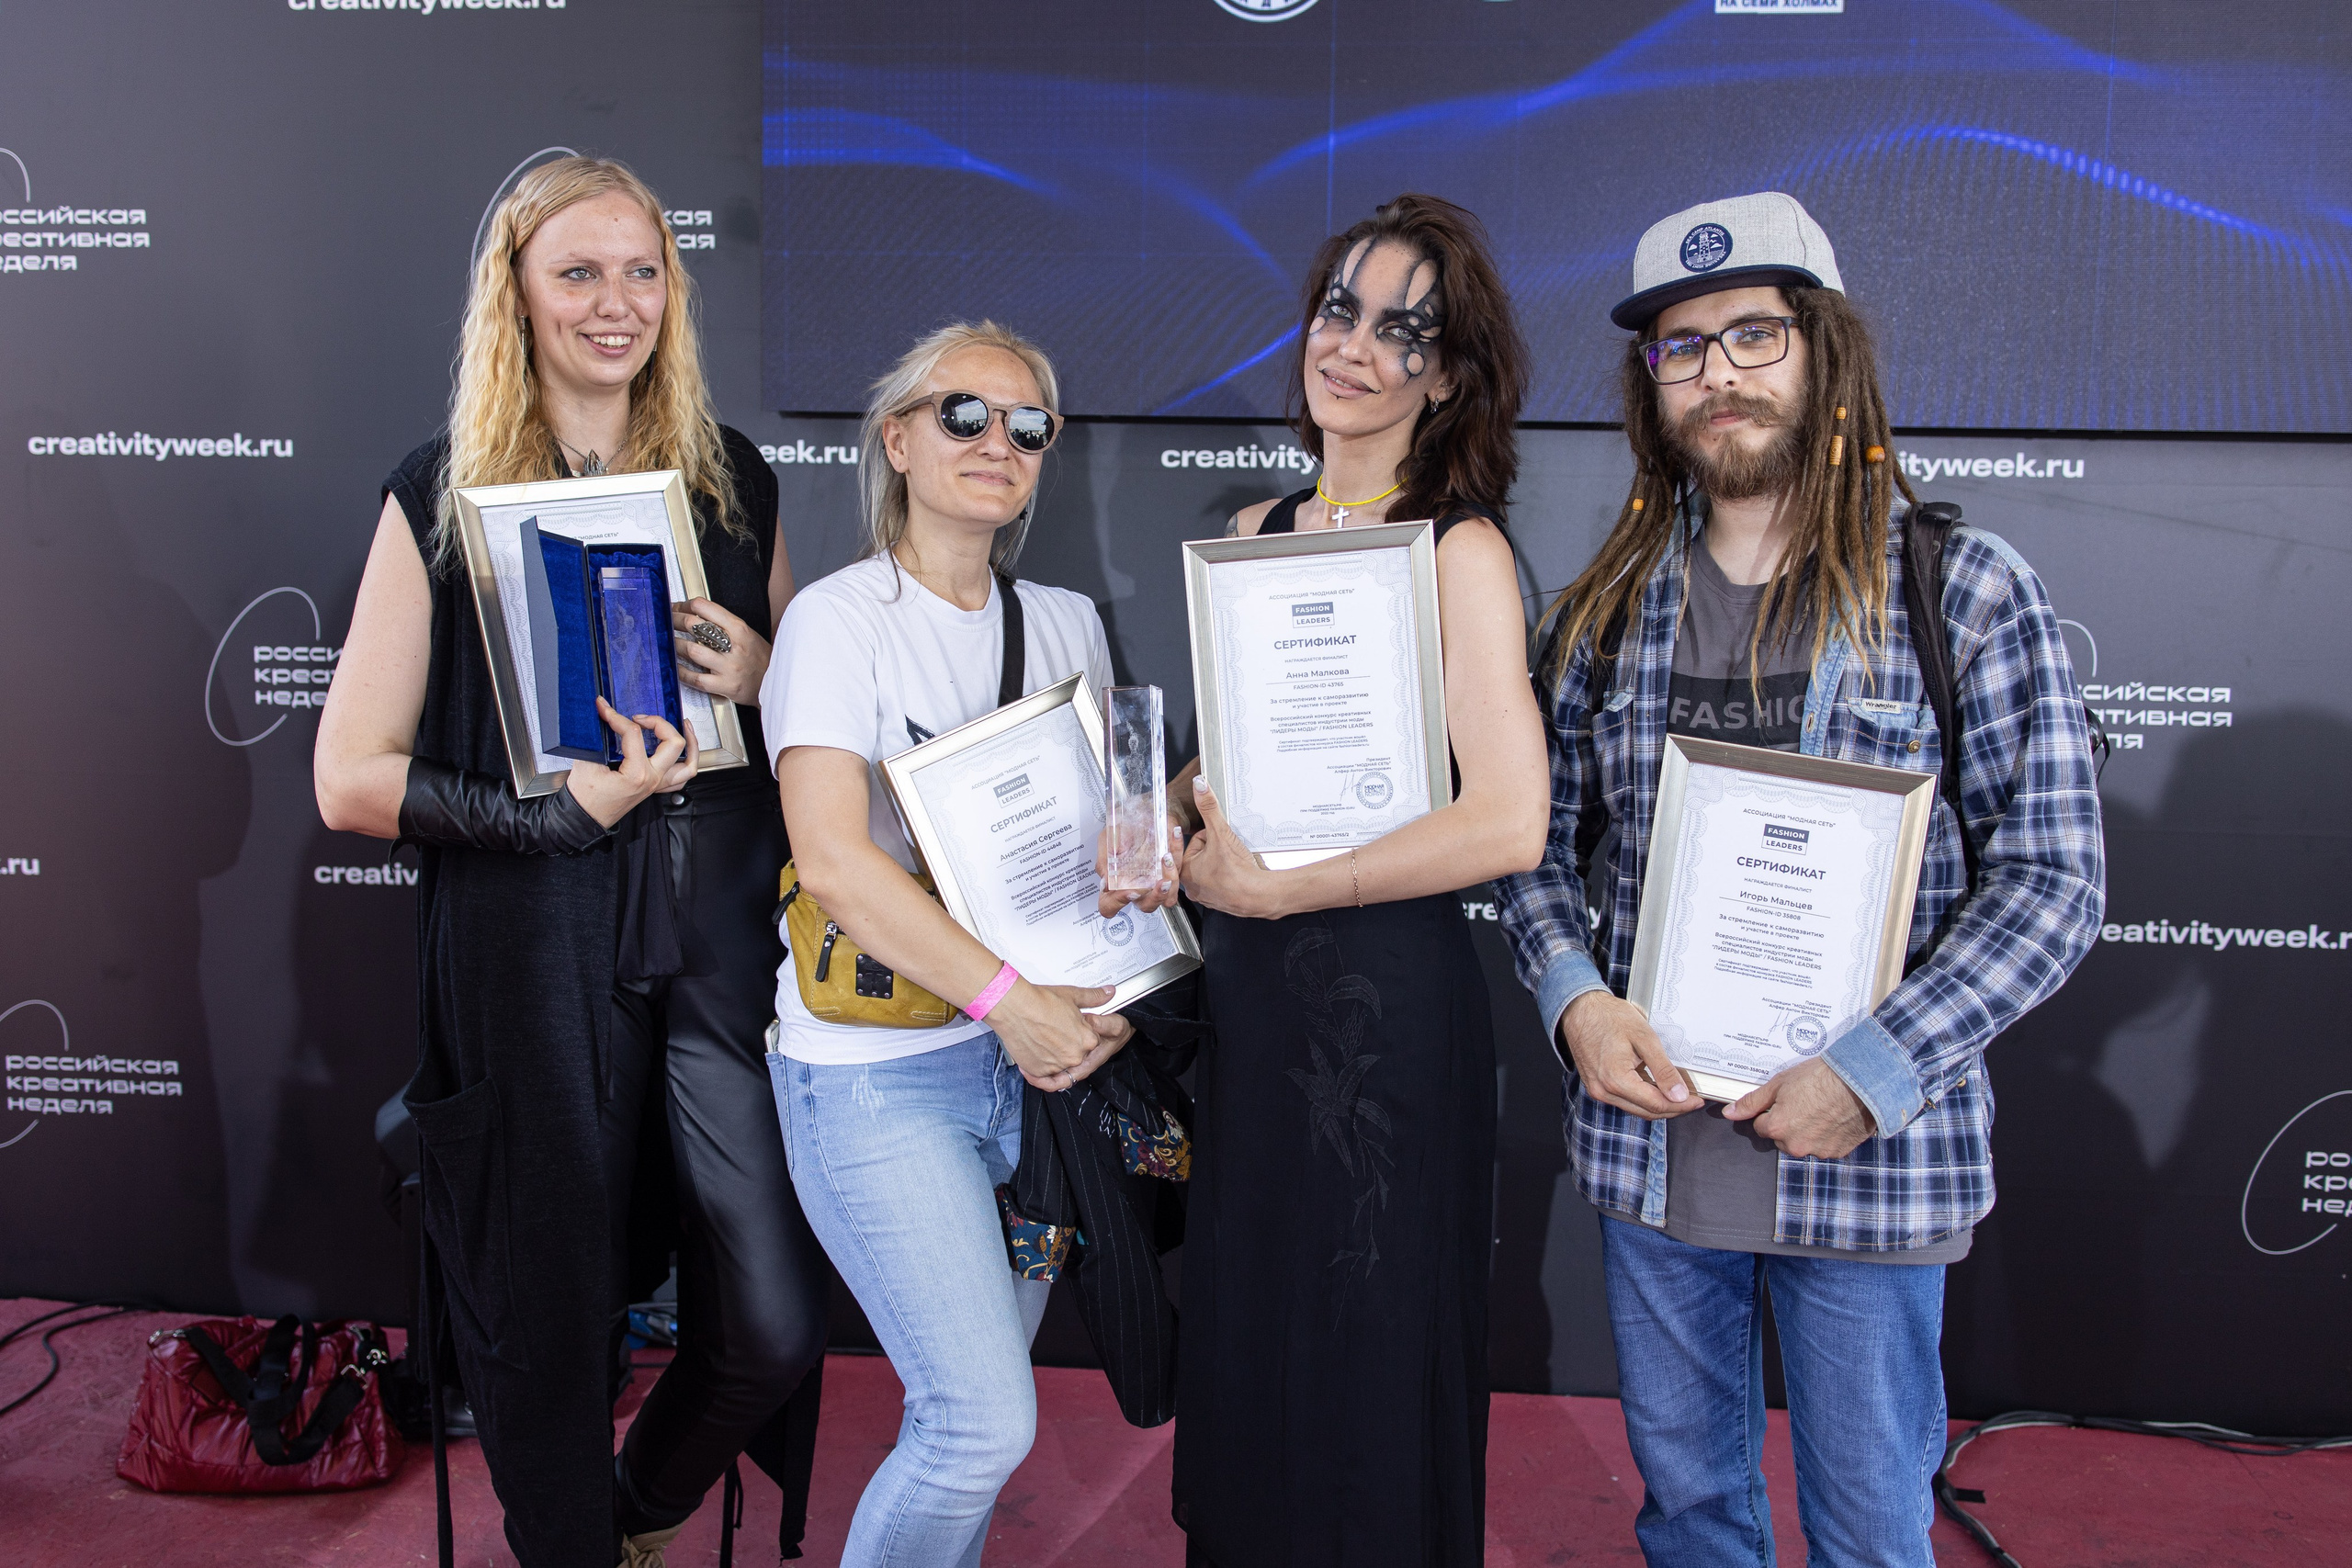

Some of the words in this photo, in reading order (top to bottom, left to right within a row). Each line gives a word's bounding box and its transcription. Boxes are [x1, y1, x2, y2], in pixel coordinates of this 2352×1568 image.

[0, 205, 147, 225] ссийская
[0, 231, 151, 248] еативная
[0, 254, 78, 274] деля
[28, 431, 294, 461] creativityweek.ru
[1269, 592, 1308, 601] АССОЦИАЦИЯ
[1295, 605, 1330, 614] FASHION
[1296, 616, 1330, 625] LEADERS
[1274, 634, 1357, 650] СЕРТИФИКАТ
[1286, 671, 1308, 679] Анна
[1311, 668, 1350, 678] Малкова
[1294, 682, 1326, 691] FASHION-ID
[2077, 682, 2231, 704] сийская
[1279, 696, 1317, 705] стремление
[1323, 693, 1369, 702] саморазвитию
[1865, 701, 1897, 710] Wrangler
[971, 773, 1004, 791] АССОЦИАЦИЯ
[1005, 761, 1027, 775] "МОДНАЯ
[1027, 755, 1041, 764] СЕТЬ"
[998, 777, 1026, 794] FASHION
[1002, 787, 1030, 804] LEADERS
[990, 795, 1058, 834] СЕРТИФИКАТ
[1743, 808, 1786, 820] АССОЦИАЦИЯ
[1787, 816, 1816, 825] "МОДНАЯ
[1000, 839, 1037, 862] Анастасия
[1038, 823, 1072, 844] Сергеева
[1768, 828, 1805, 840] FASHION
[1766, 840, 1803, 852] LEADERS
[1012, 863, 1044, 882] стремление
[1047, 844, 1084, 865] саморазвитию
[1736, 856, 1826, 880] СЕРТИФИКАТ
[1740, 891, 1769, 903] Игорь
[1770, 897, 1813, 911] Мальцев
[1747, 906, 1781, 917] FASHION-ID
[1782, 912, 1802, 921] 35808
[1728, 916, 1769, 929] стремление
[1775, 925, 1825, 939] саморазвитию
[1746, 927, 1769, 935] участие
[1775, 932, 1799, 941] проекте
[1715, 932, 1760, 946] Всероссийский
[1761, 942, 1785, 951] конкурс
[1787, 946, 1823, 957] креативных
[1712, 945, 1739, 954] "ЛИДЕРЫ
[1740, 951, 1762, 959] МОДЫ"
[1768, 955, 1793, 964] FASHION
[1794, 961, 1822, 970] LEADERS
[6, 1055, 179, 1076] российская
[6, 1076, 183, 1096] креативная
[7, 1096, 114, 1115] неделя
[2305, 1150, 2352, 1168] ро
[2303, 1174, 2352, 1192] кр
